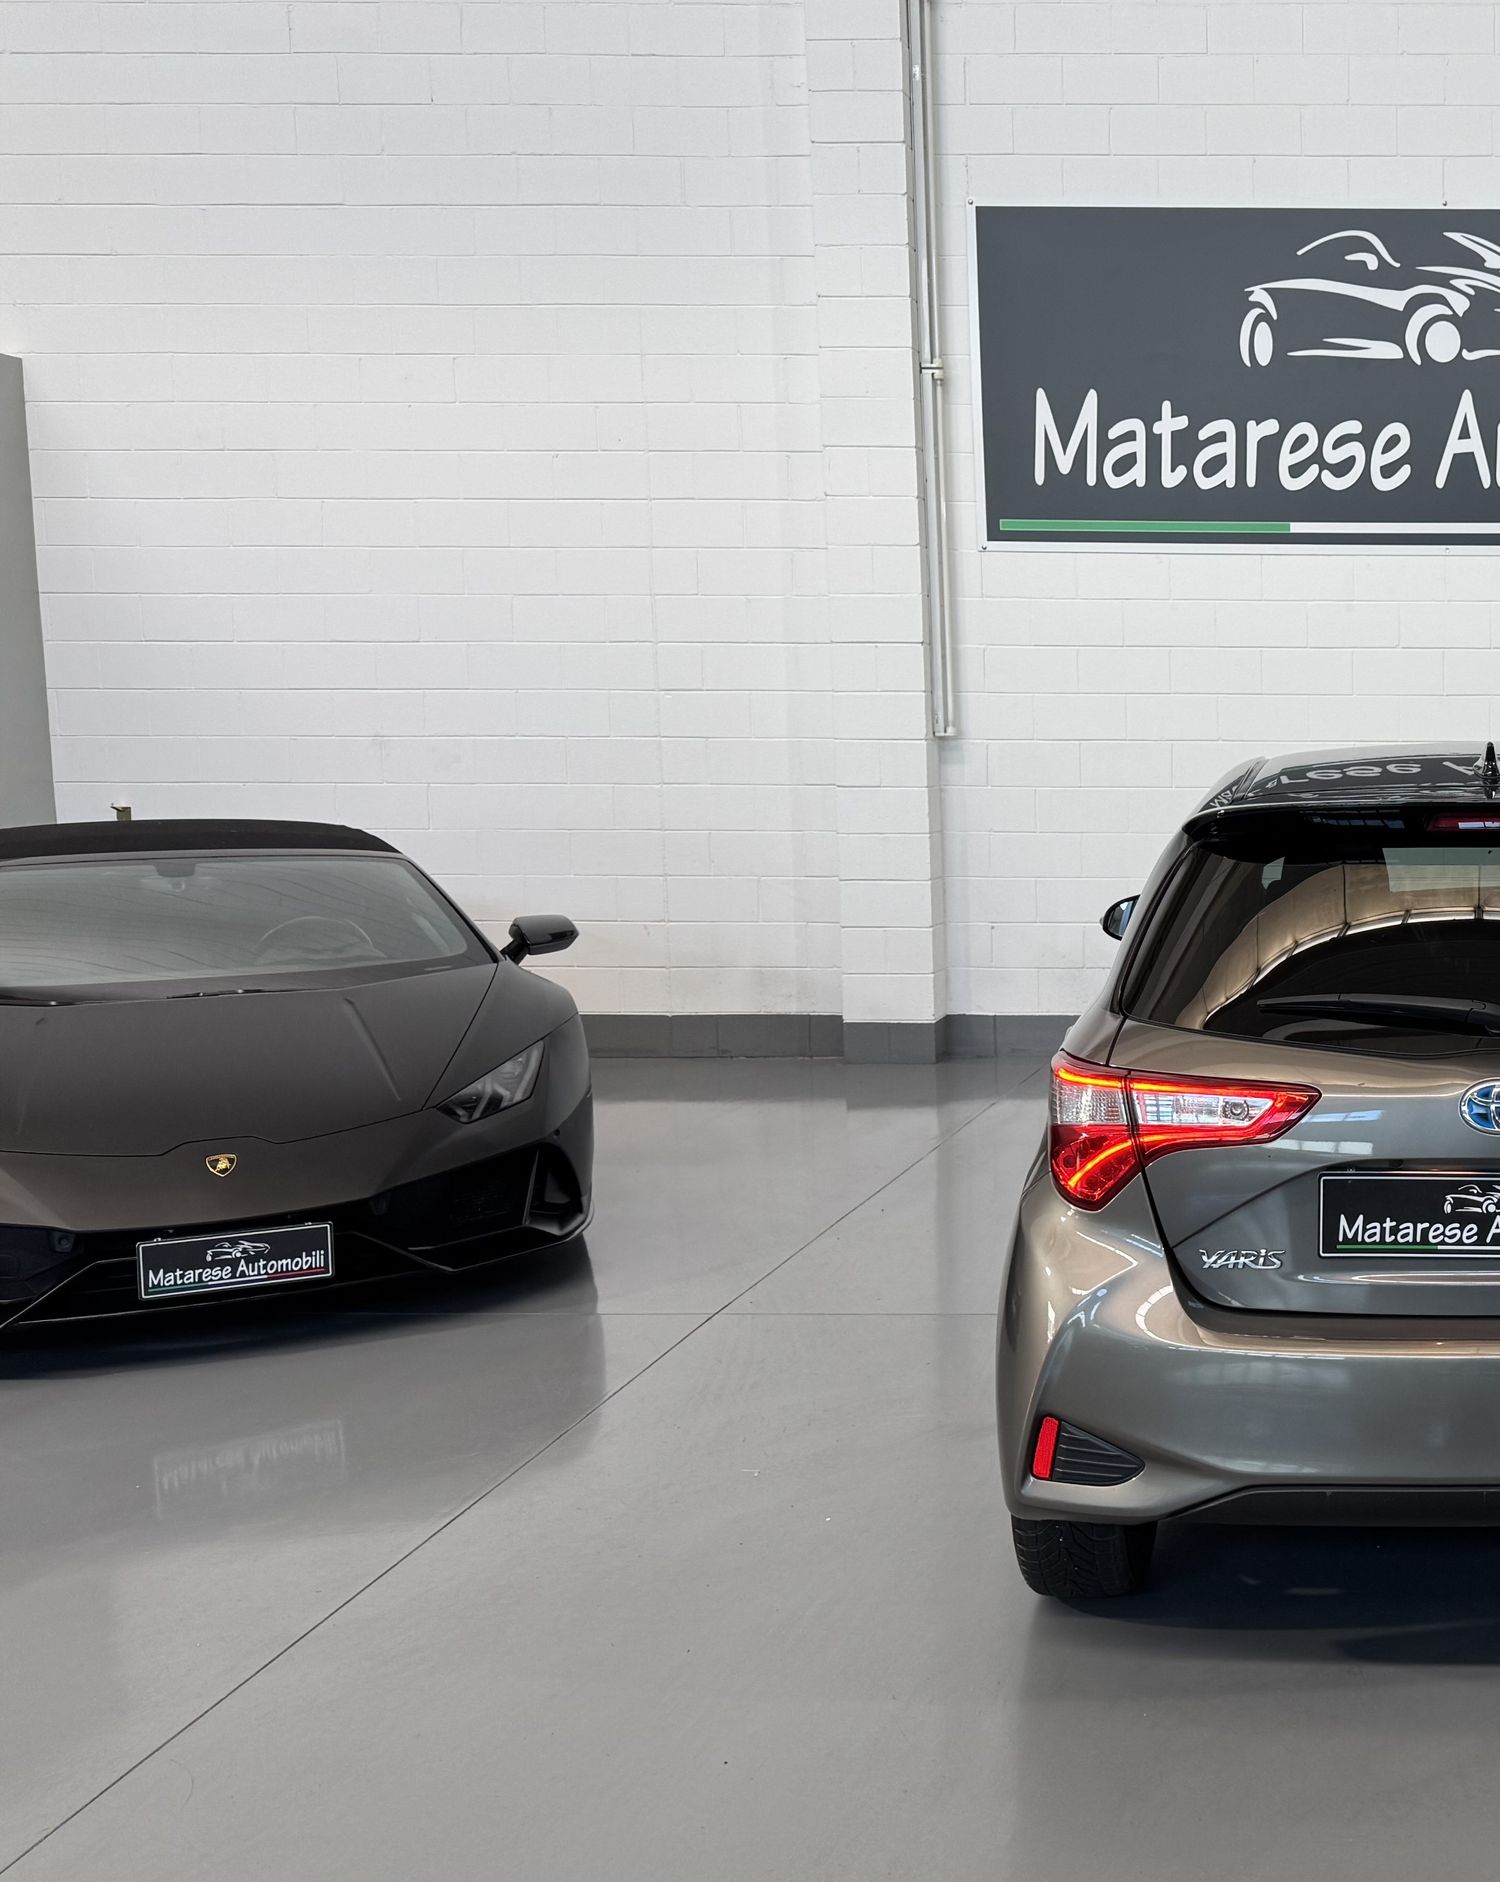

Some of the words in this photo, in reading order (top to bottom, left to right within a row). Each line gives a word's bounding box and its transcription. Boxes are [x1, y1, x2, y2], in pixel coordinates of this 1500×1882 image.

[1033, 387, 1412, 491] Matarese
[1338, 1213, 1478, 1244] Matarese
[148, 1265, 232, 1288] Matarese
[235, 1250, 325, 1278] Automobili
